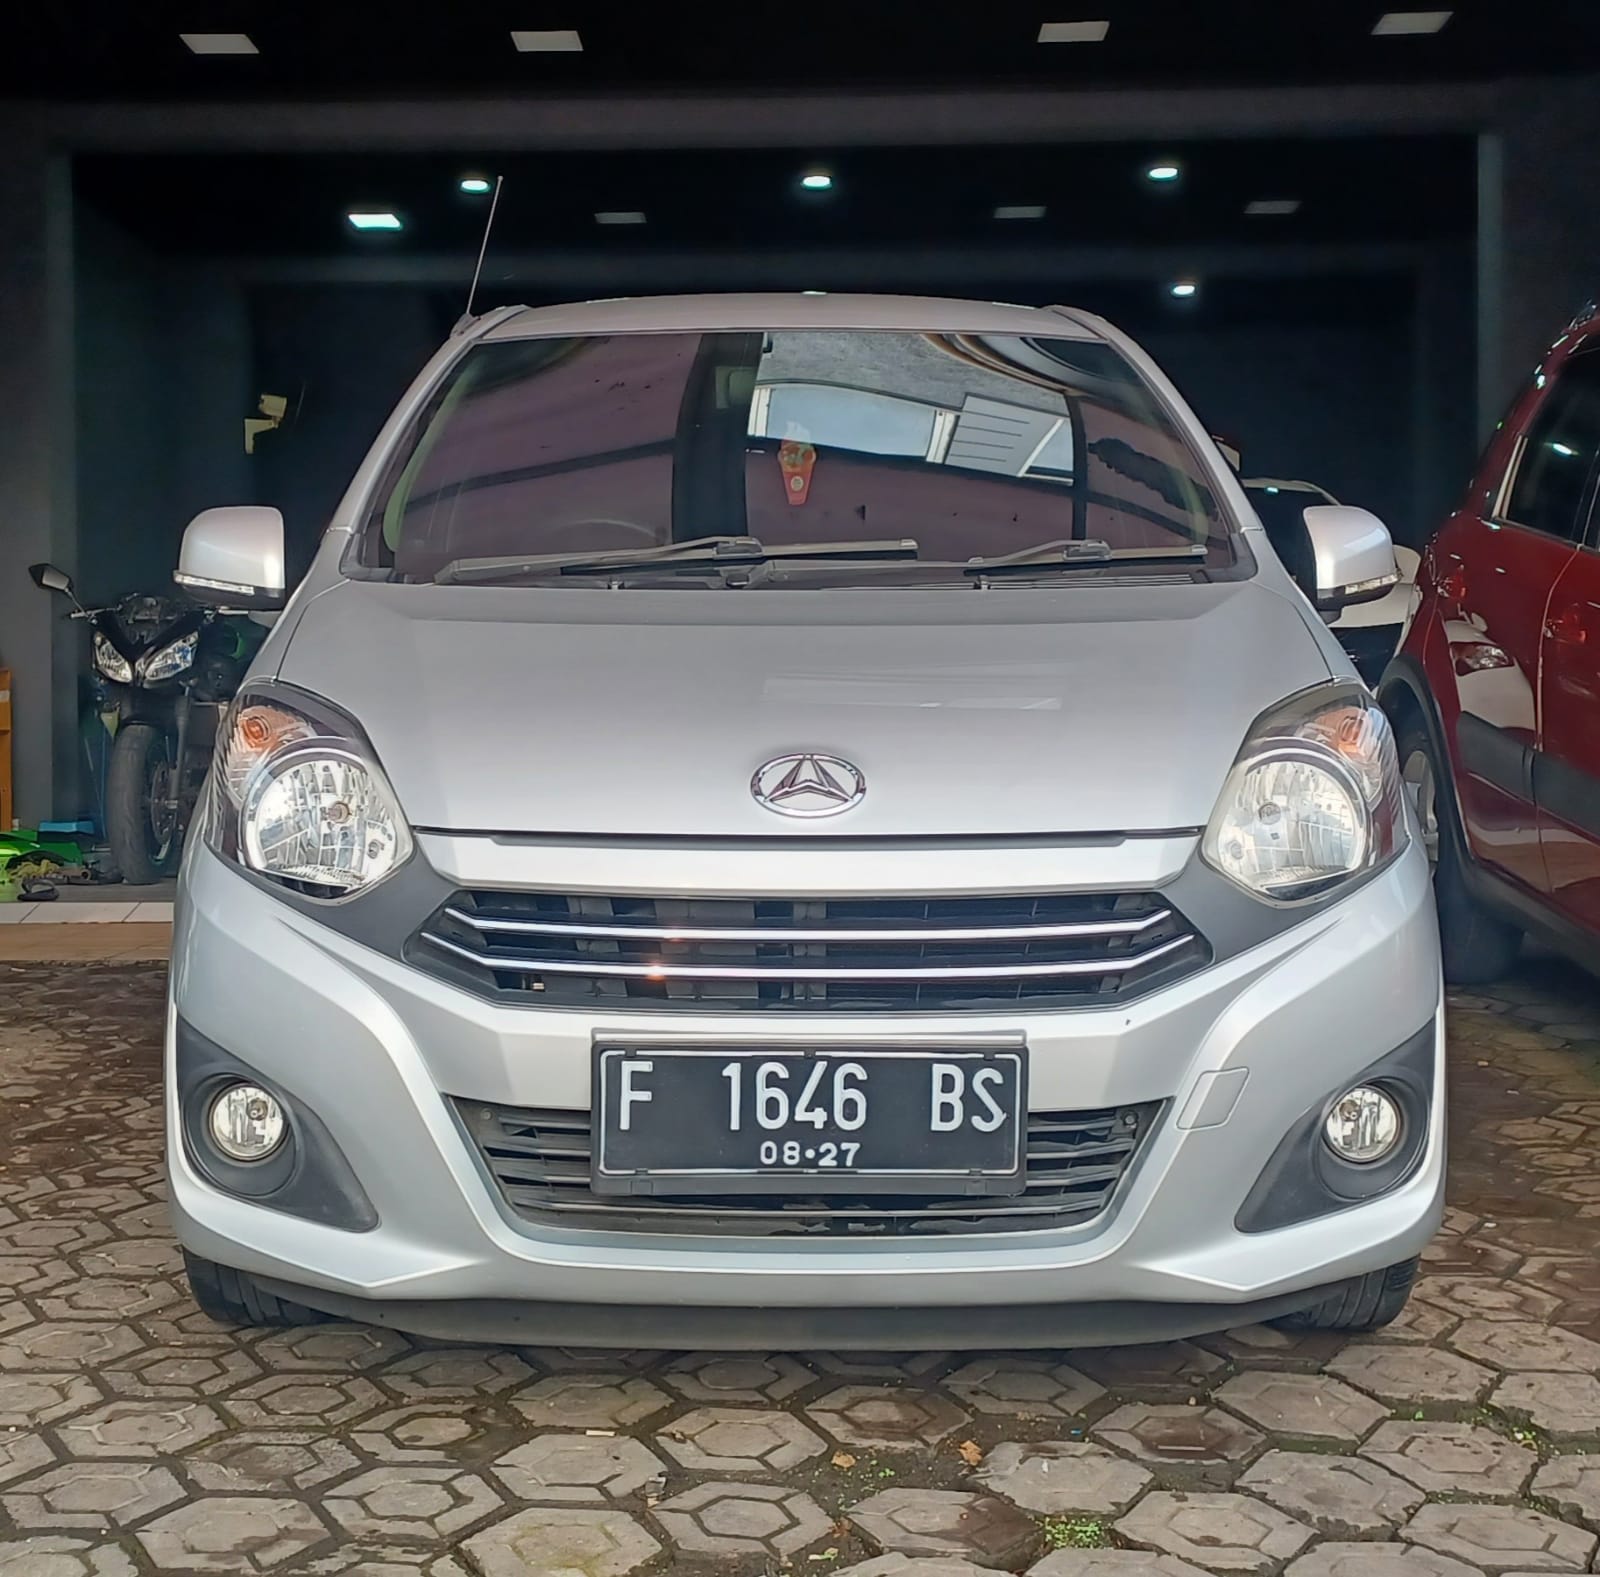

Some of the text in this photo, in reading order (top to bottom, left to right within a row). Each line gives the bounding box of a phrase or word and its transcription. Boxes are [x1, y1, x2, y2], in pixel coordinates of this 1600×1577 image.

[619, 1060, 1007, 1132] F 1646 BS
